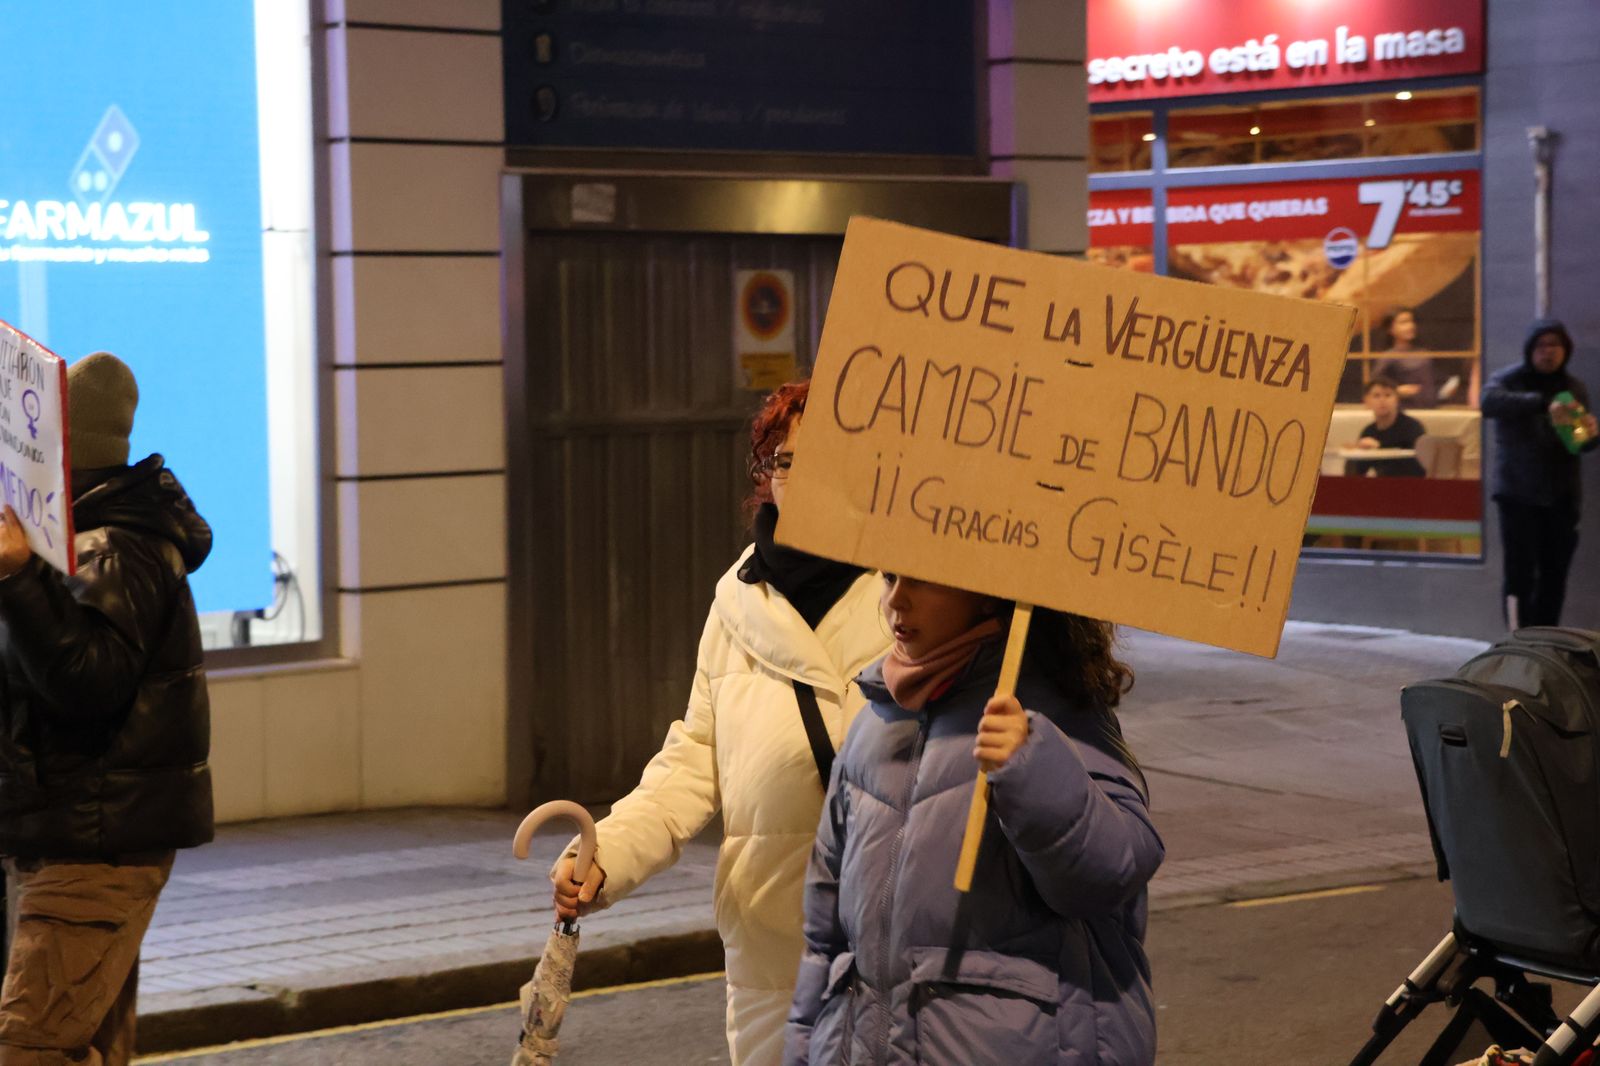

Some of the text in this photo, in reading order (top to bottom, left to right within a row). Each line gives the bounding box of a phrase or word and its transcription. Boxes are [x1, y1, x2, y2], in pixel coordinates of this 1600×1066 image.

[1088, 26, 1465, 84] secreto está en la masa
[1117, 207, 1131, 224] Y
[1208, 202, 1246, 225] QUE
[1249, 197, 1329, 222] QUIERAS
[885, 261, 1312, 392] QUE LA VERGÜENZA
[832, 345, 1306, 505] CAMBIE DE BANDO
